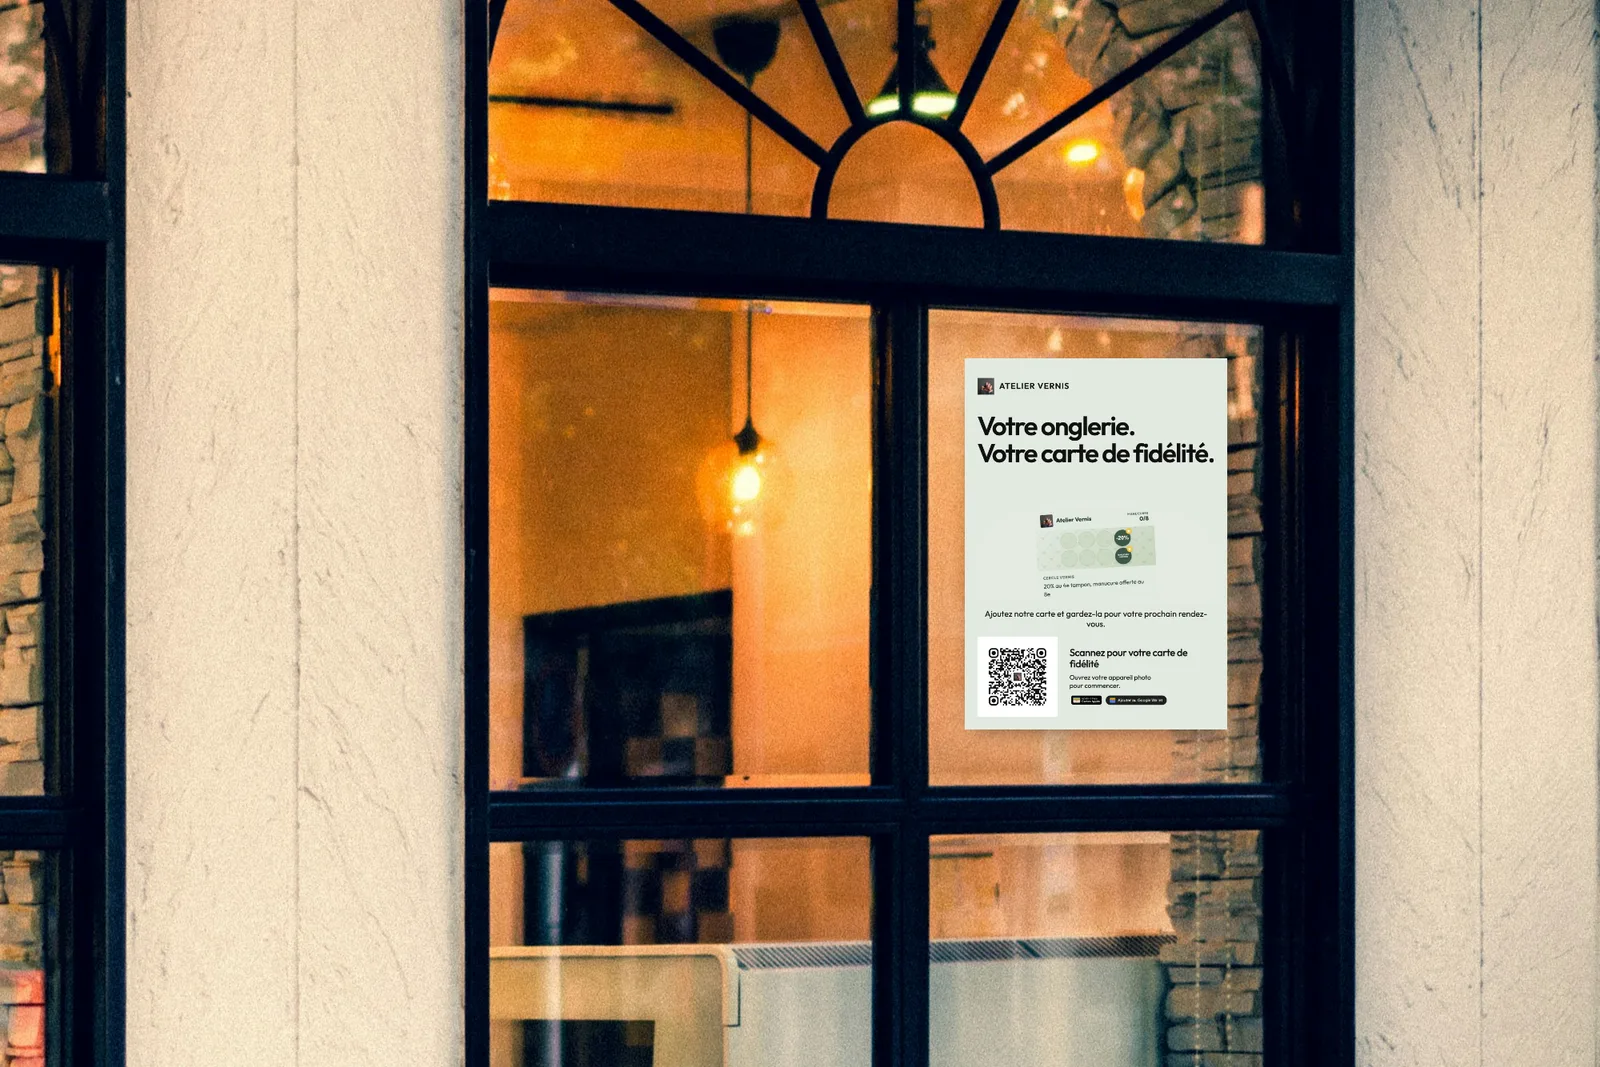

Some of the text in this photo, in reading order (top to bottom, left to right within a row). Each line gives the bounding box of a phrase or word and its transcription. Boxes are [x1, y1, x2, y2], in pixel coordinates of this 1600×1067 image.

[999, 382, 1070, 390] ATELIER VERNIS
[977, 416, 1135, 441] Votre onglerie.
[977, 442, 1215, 463] Votre carte de fidélité.
[1056, 516, 1074, 524] Atelier
[984, 609, 1208, 620] Ajoutez notre carte et gardez-la pour votre prochain rendez-
[1069, 647, 1188, 659] Scannez pour votre carte de
[1069, 659, 1100, 668] fidélité
[1108, 674, 1133, 682] appareil
[1134, 674, 1152, 682] photo
